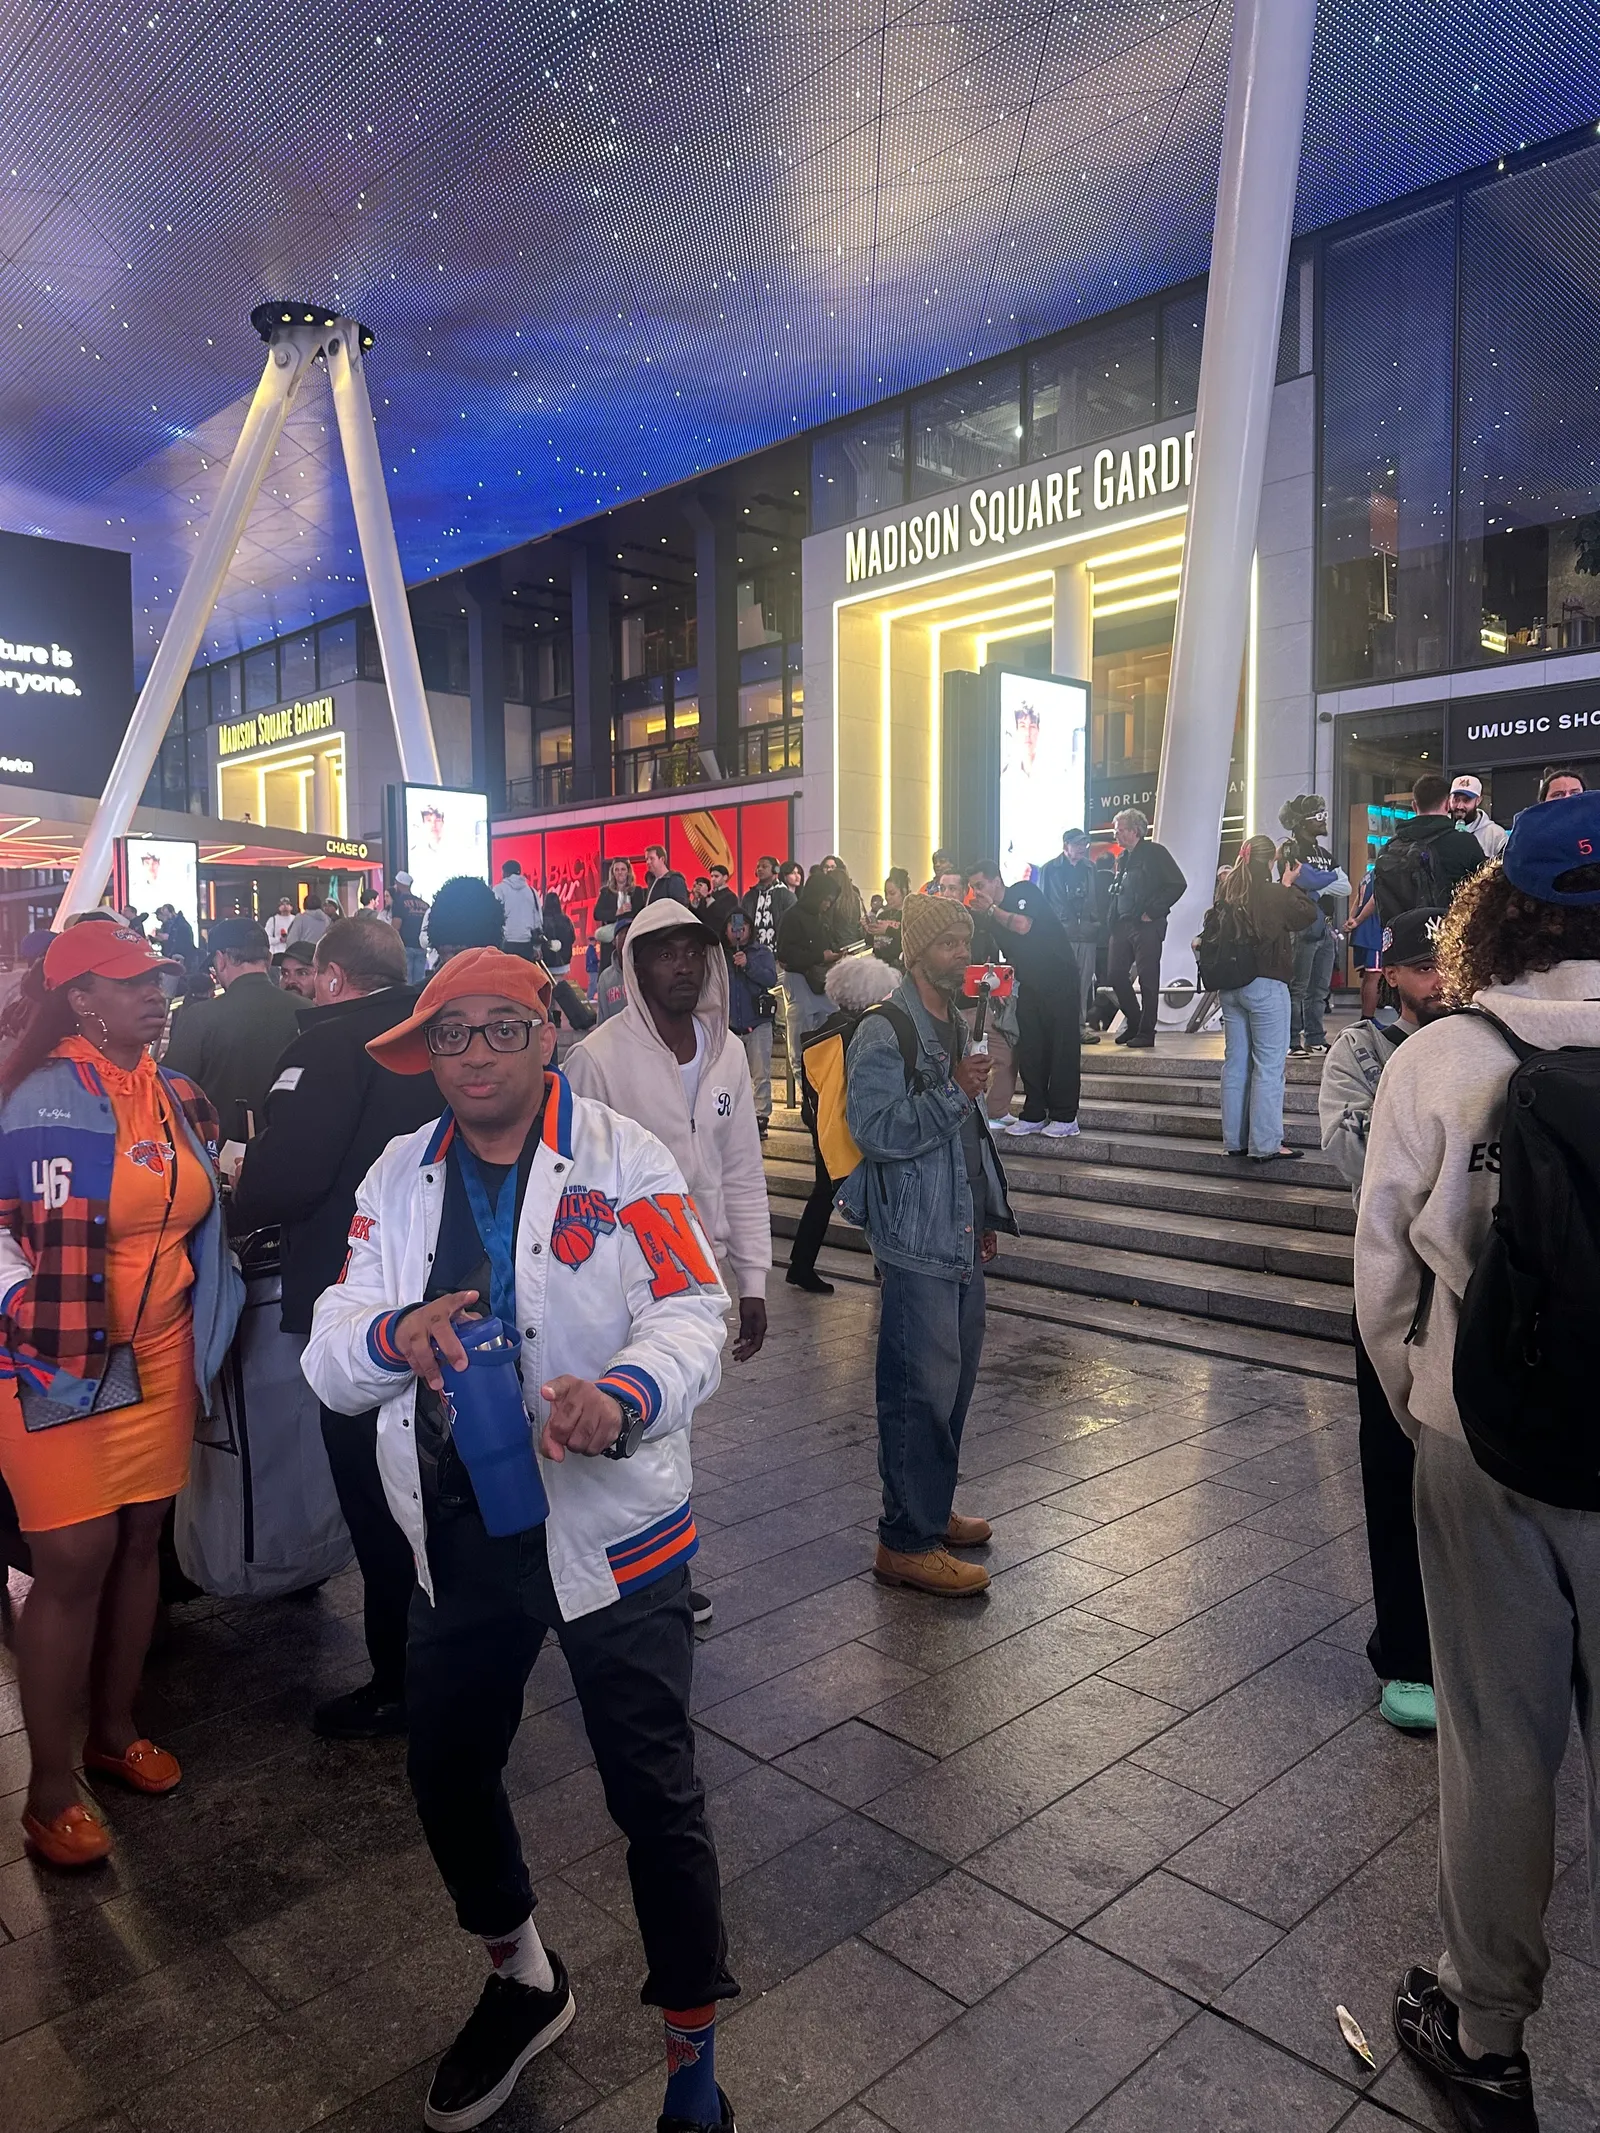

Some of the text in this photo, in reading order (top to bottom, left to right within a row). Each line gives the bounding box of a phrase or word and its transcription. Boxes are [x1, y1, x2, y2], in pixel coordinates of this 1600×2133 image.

[846, 503, 960, 583] MADISON
[969, 465, 1082, 546] SQUARE
[51, 643, 74, 668] is
[219, 696, 334, 756] MADISON SQUARE GARDEN
[1467, 716, 1551, 740] UMUSIC
[326, 840, 358, 856] CHASE
[1577, 838, 1593, 855] 5
[548, 851, 600, 887] BACK
[31, 1157, 73, 1210] 46
[555, 1189, 616, 1225] ICKS
